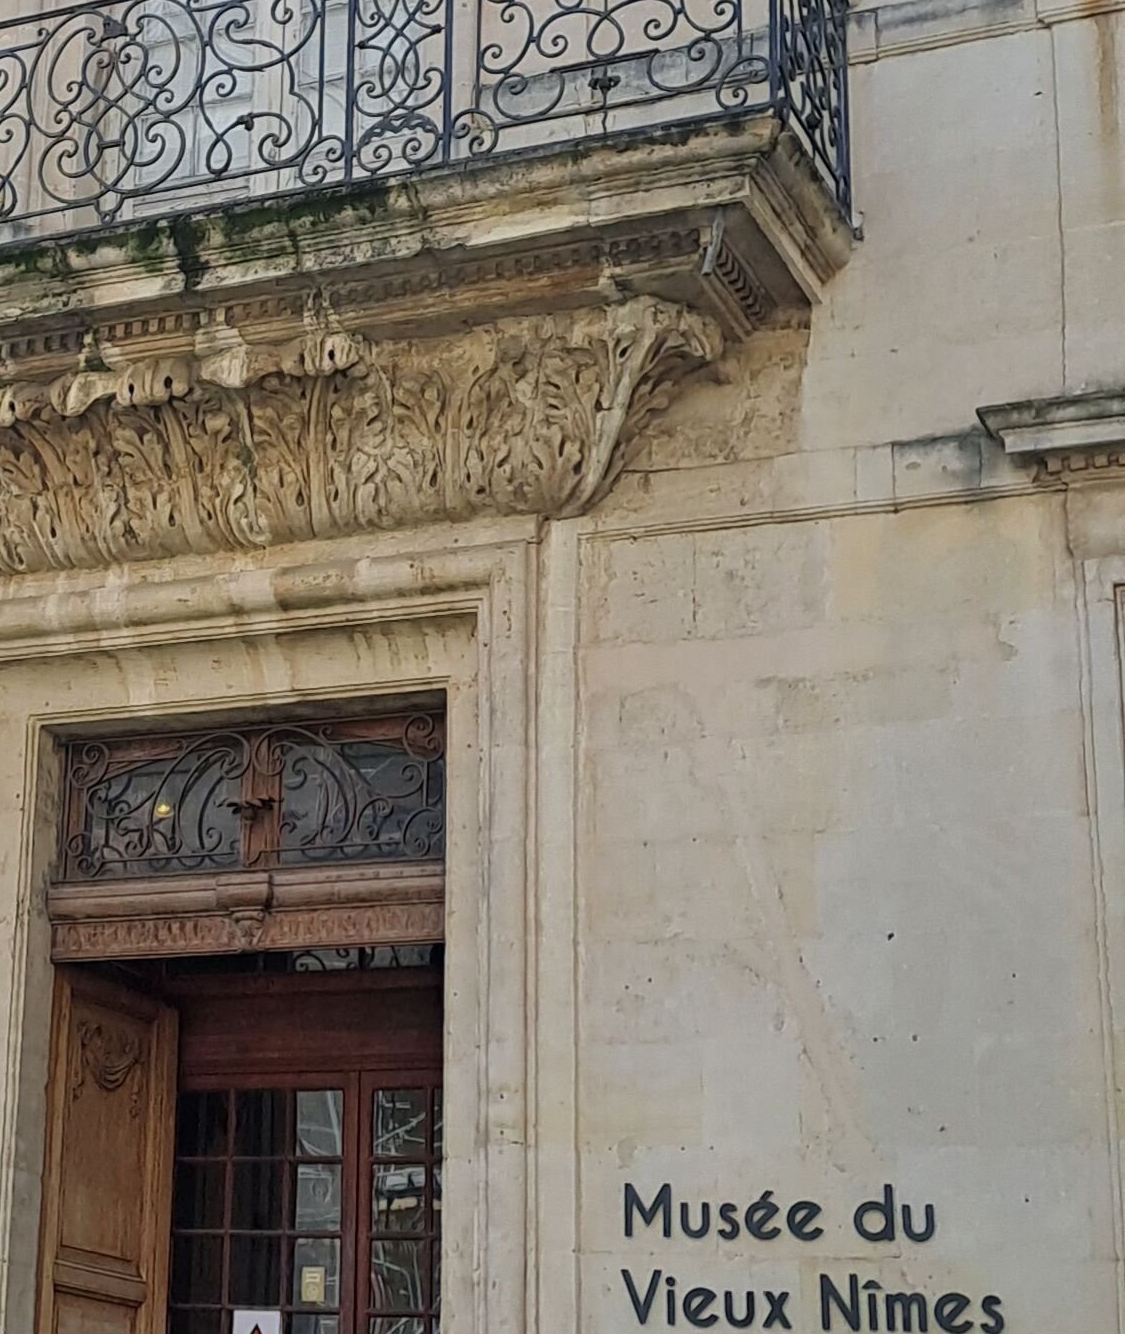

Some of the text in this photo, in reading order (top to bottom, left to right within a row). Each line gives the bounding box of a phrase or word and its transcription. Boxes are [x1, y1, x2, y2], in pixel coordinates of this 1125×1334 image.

[623, 1182, 936, 1242] Musée du
[620, 1269, 793, 1329] Vieux
